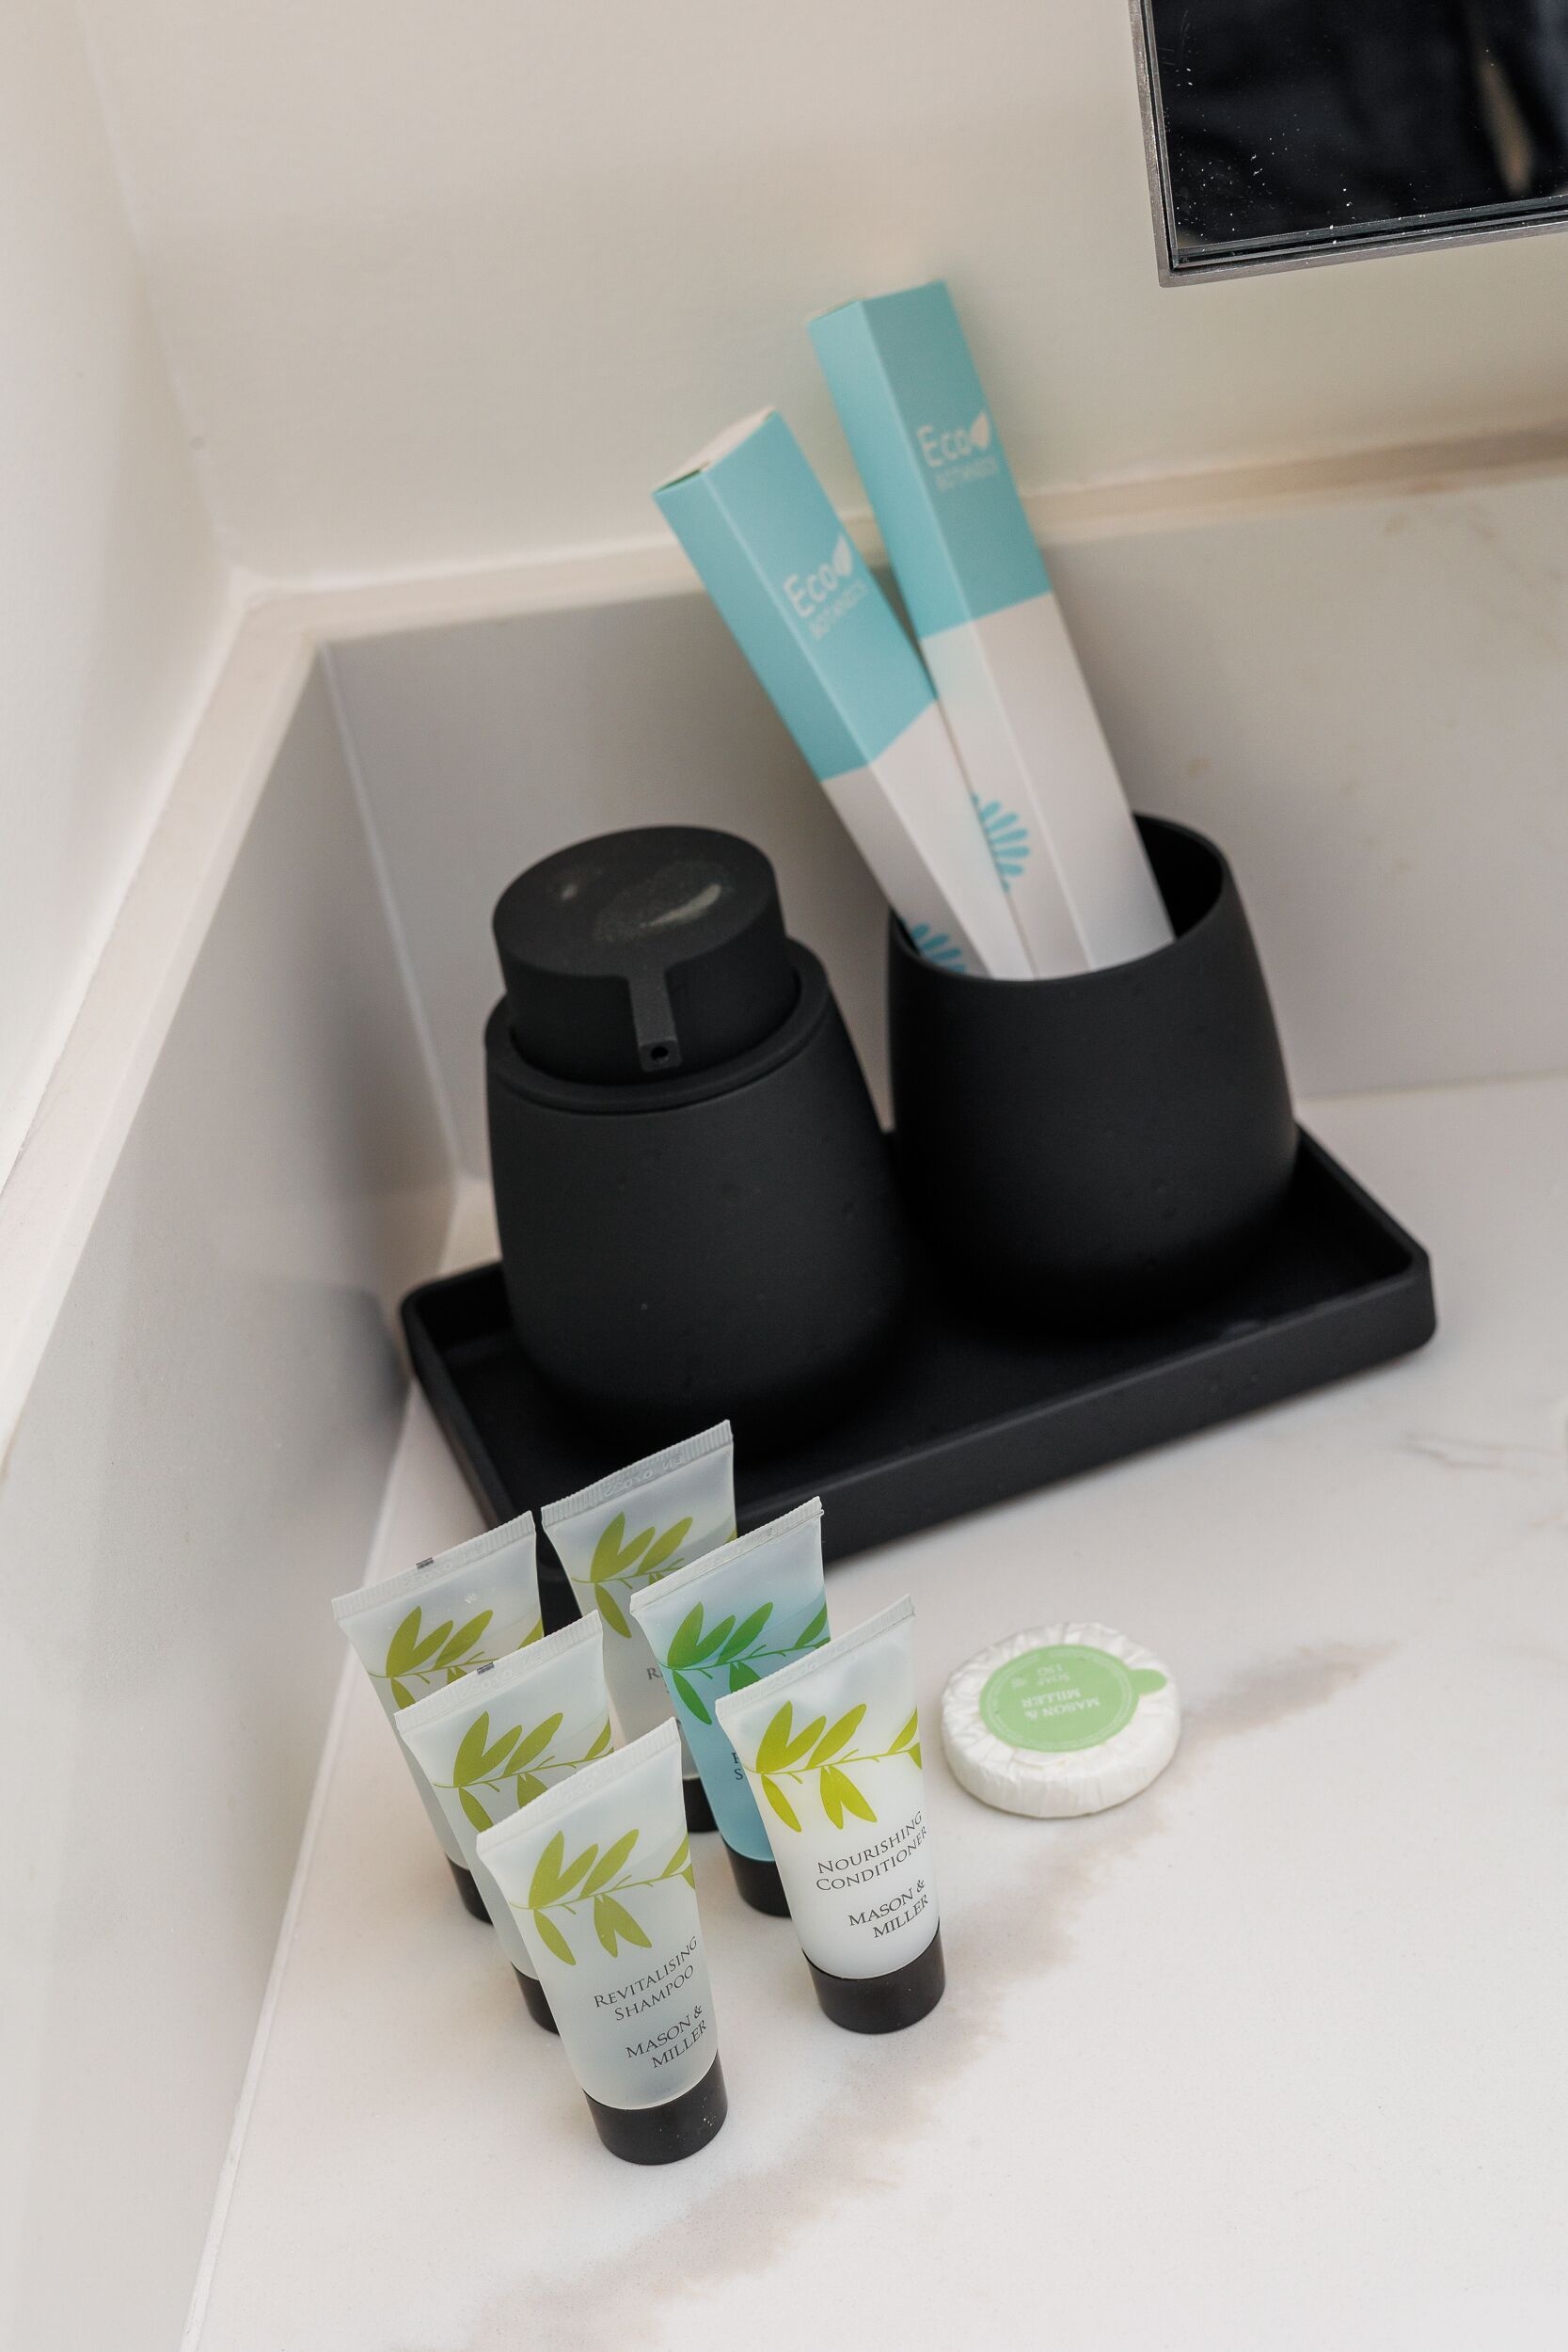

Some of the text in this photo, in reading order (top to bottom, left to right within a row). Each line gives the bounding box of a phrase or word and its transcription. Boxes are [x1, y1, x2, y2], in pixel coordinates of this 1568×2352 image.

[916, 424, 973, 468] Eco
[783, 563, 839, 618] Eco
[1022, 1688, 1081, 1708] MILLER
[1023, 1696, 1100, 1721] MASON &
[816, 1826, 927, 1891] CONDITIONER
[817, 1811, 923, 1874] NOURISHING
[847, 1879, 926, 1927] MASON &
[872, 1895, 929, 1939] MILLER
[594, 1935, 698, 2008] REVITALISING
[614, 1964, 694, 2021] SHAMPOO
[626, 2005, 703, 2058] MASON &
[652, 2020, 707, 2069] MILLER
